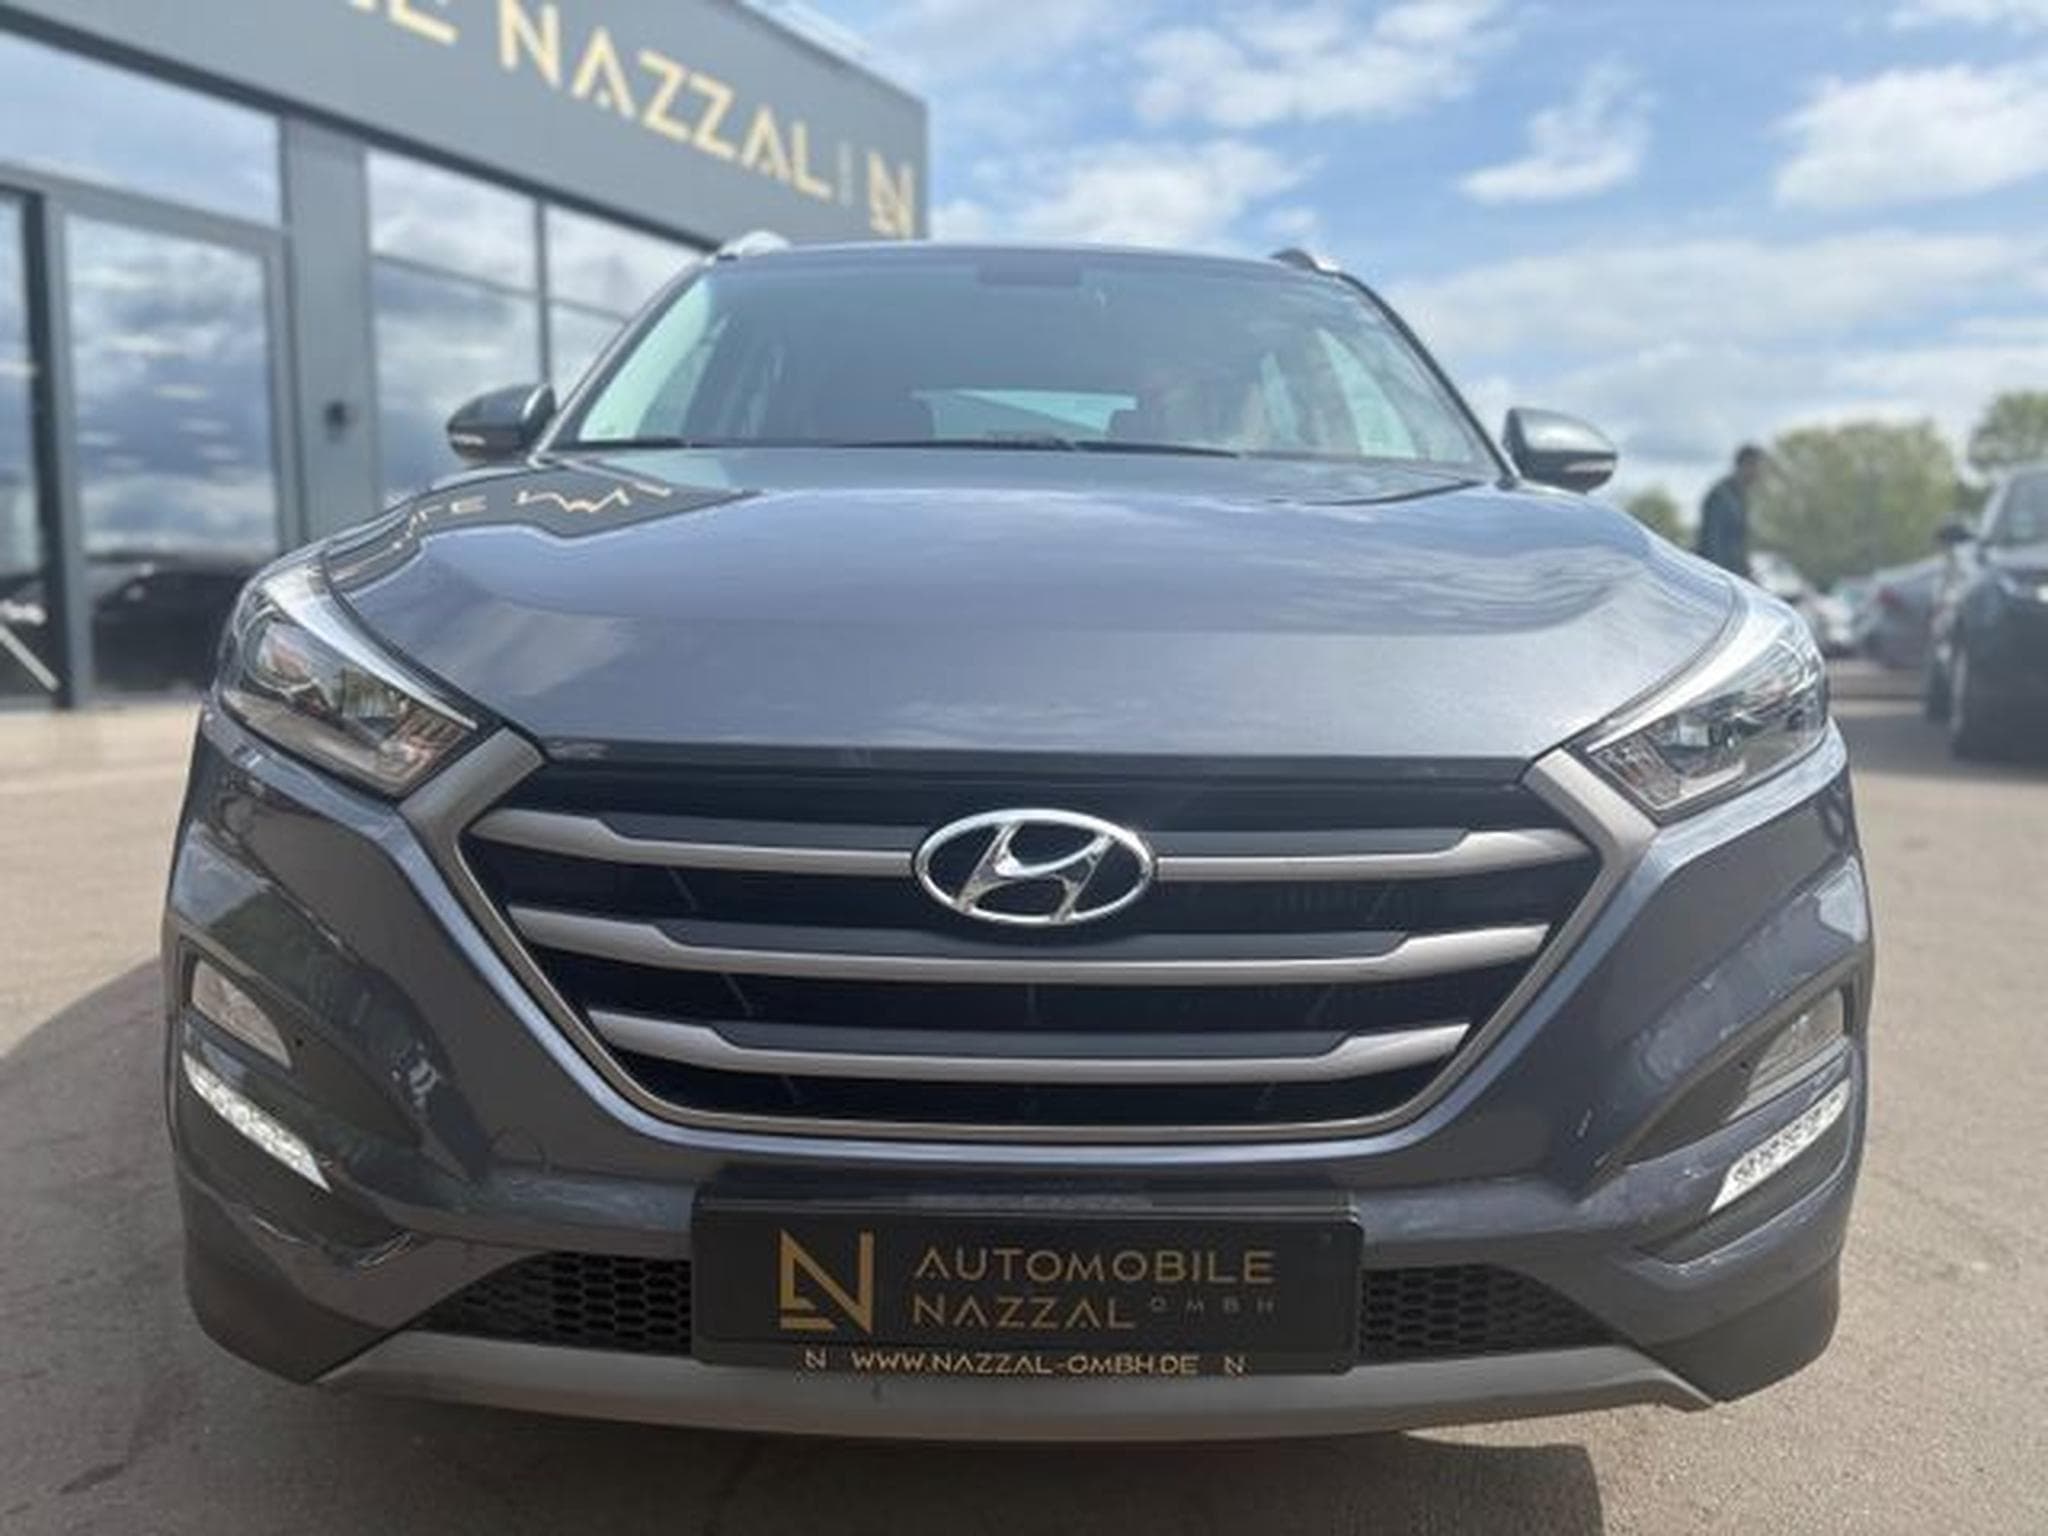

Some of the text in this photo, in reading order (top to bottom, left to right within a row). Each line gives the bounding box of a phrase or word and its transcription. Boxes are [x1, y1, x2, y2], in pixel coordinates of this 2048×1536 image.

[498, 0, 834, 201] NAZZAL
[915, 1246, 1275, 1283] AUTOMOBILE
[913, 1294, 1135, 1329] NAZZAL
